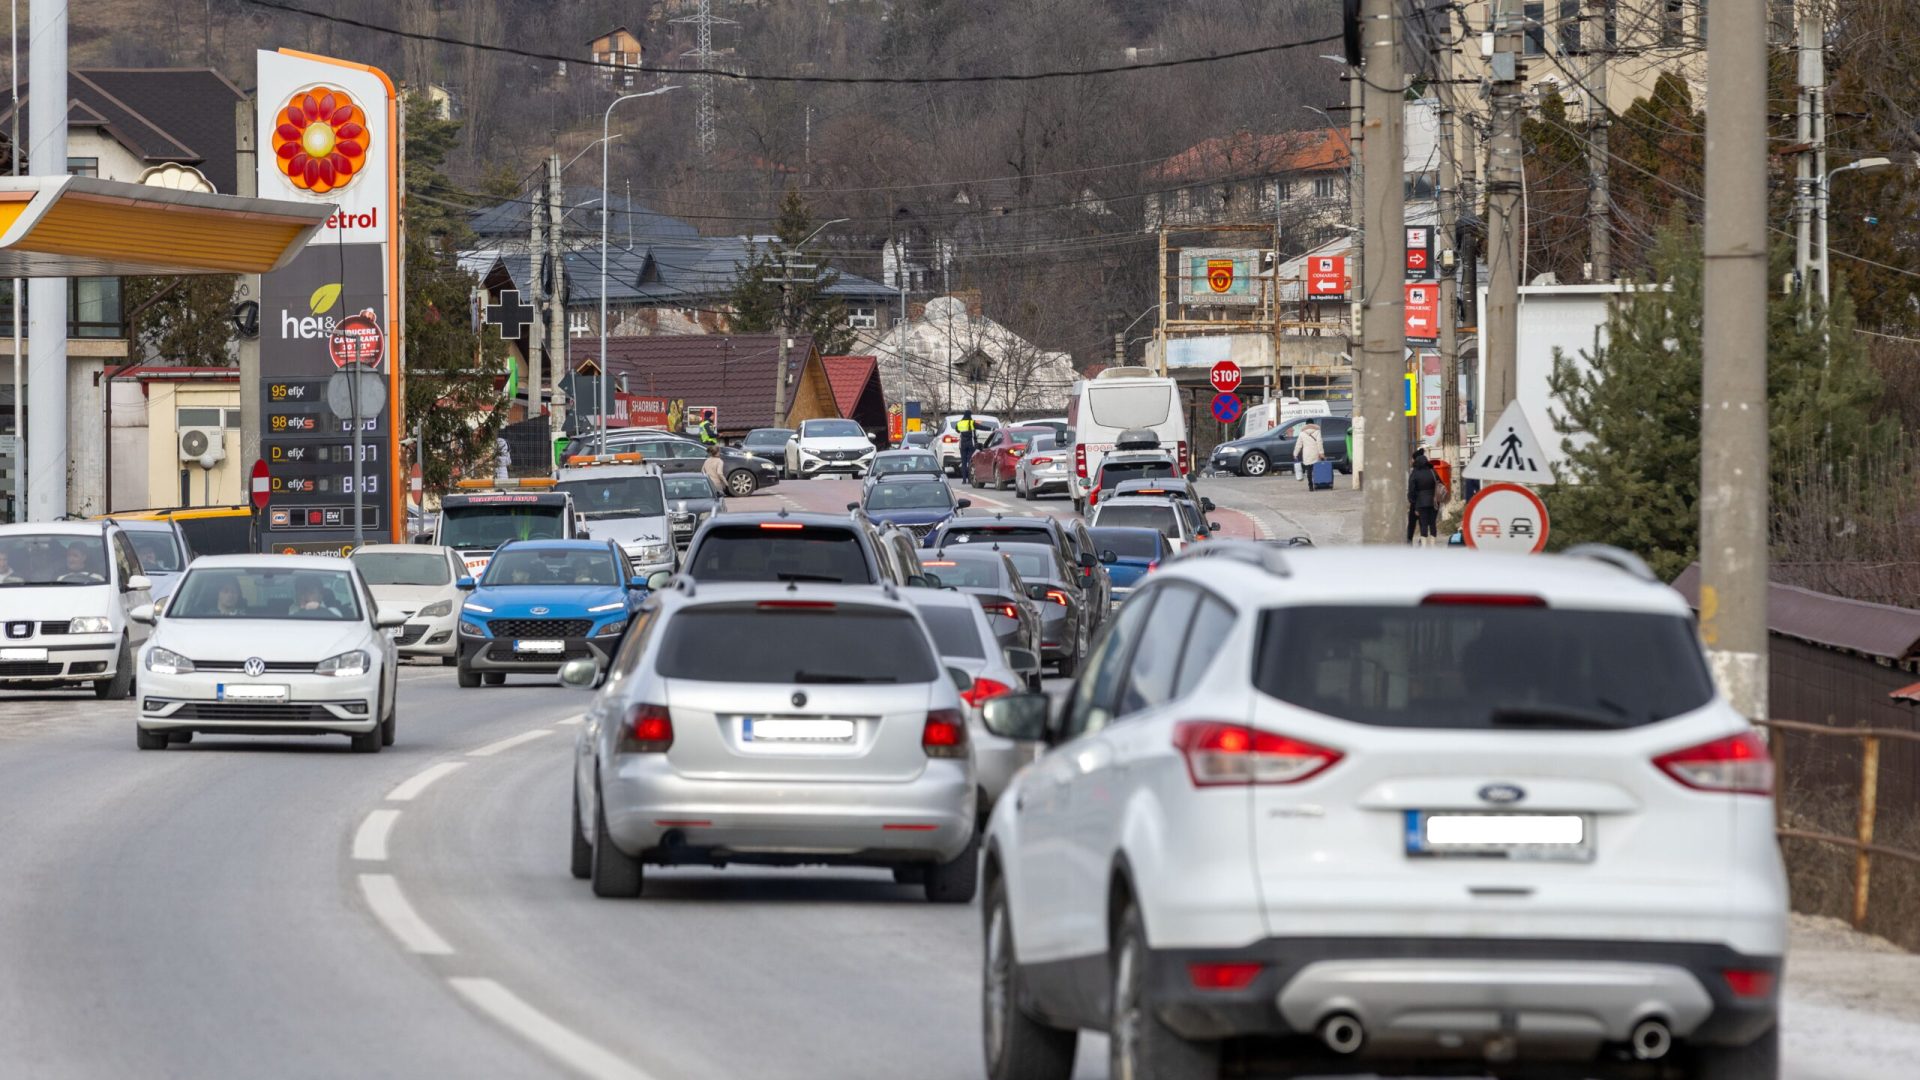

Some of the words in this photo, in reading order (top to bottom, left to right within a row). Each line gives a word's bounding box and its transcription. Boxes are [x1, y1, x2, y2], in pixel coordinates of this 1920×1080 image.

[1212, 370, 1240, 382] STOP
[271, 385, 287, 397] 95
[287, 386, 305, 398] efix
[632, 400, 665, 412] SHAORMERA
[271, 415, 287, 427] 98
[272, 447, 281, 459] D
[287, 448, 304, 460] efix
[272, 478, 281, 490] D
